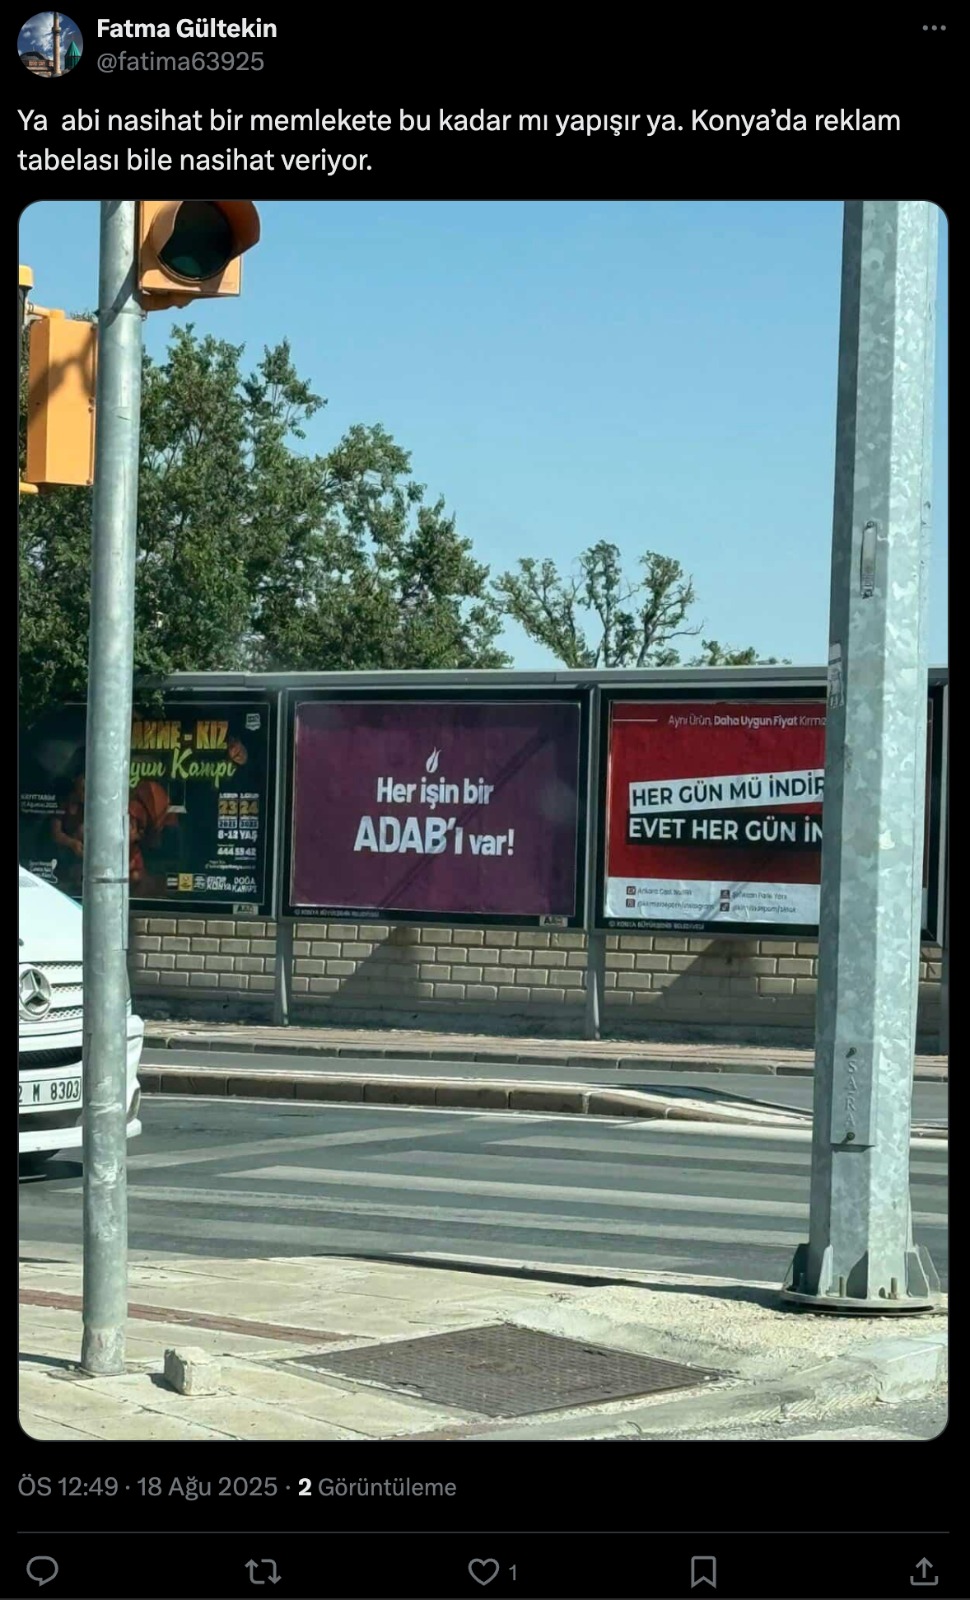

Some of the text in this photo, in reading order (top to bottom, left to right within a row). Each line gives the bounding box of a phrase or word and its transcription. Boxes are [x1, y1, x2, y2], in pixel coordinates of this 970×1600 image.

[196, 721, 228, 749] KIZ
[668, 714, 687, 728] Aynı
[714, 715, 739, 726] Daha
[742, 715, 772, 729] Uygun
[774, 714, 798, 728] Fiyat
[129, 748, 236, 788] yun Kampı
[377, 777, 494, 809] Her işin bir
[632, 772, 824, 806] HER GÜN MÜ İNDİR
[219, 800, 258, 815] 23 24
[239, 830, 257, 843] YAŞ
[469, 829, 515, 856] var!
[629, 815, 823, 843] EVET HER GÜN İN
[33, 1083, 40, 1102] M
[51, 1080, 79, 1100] 8303
